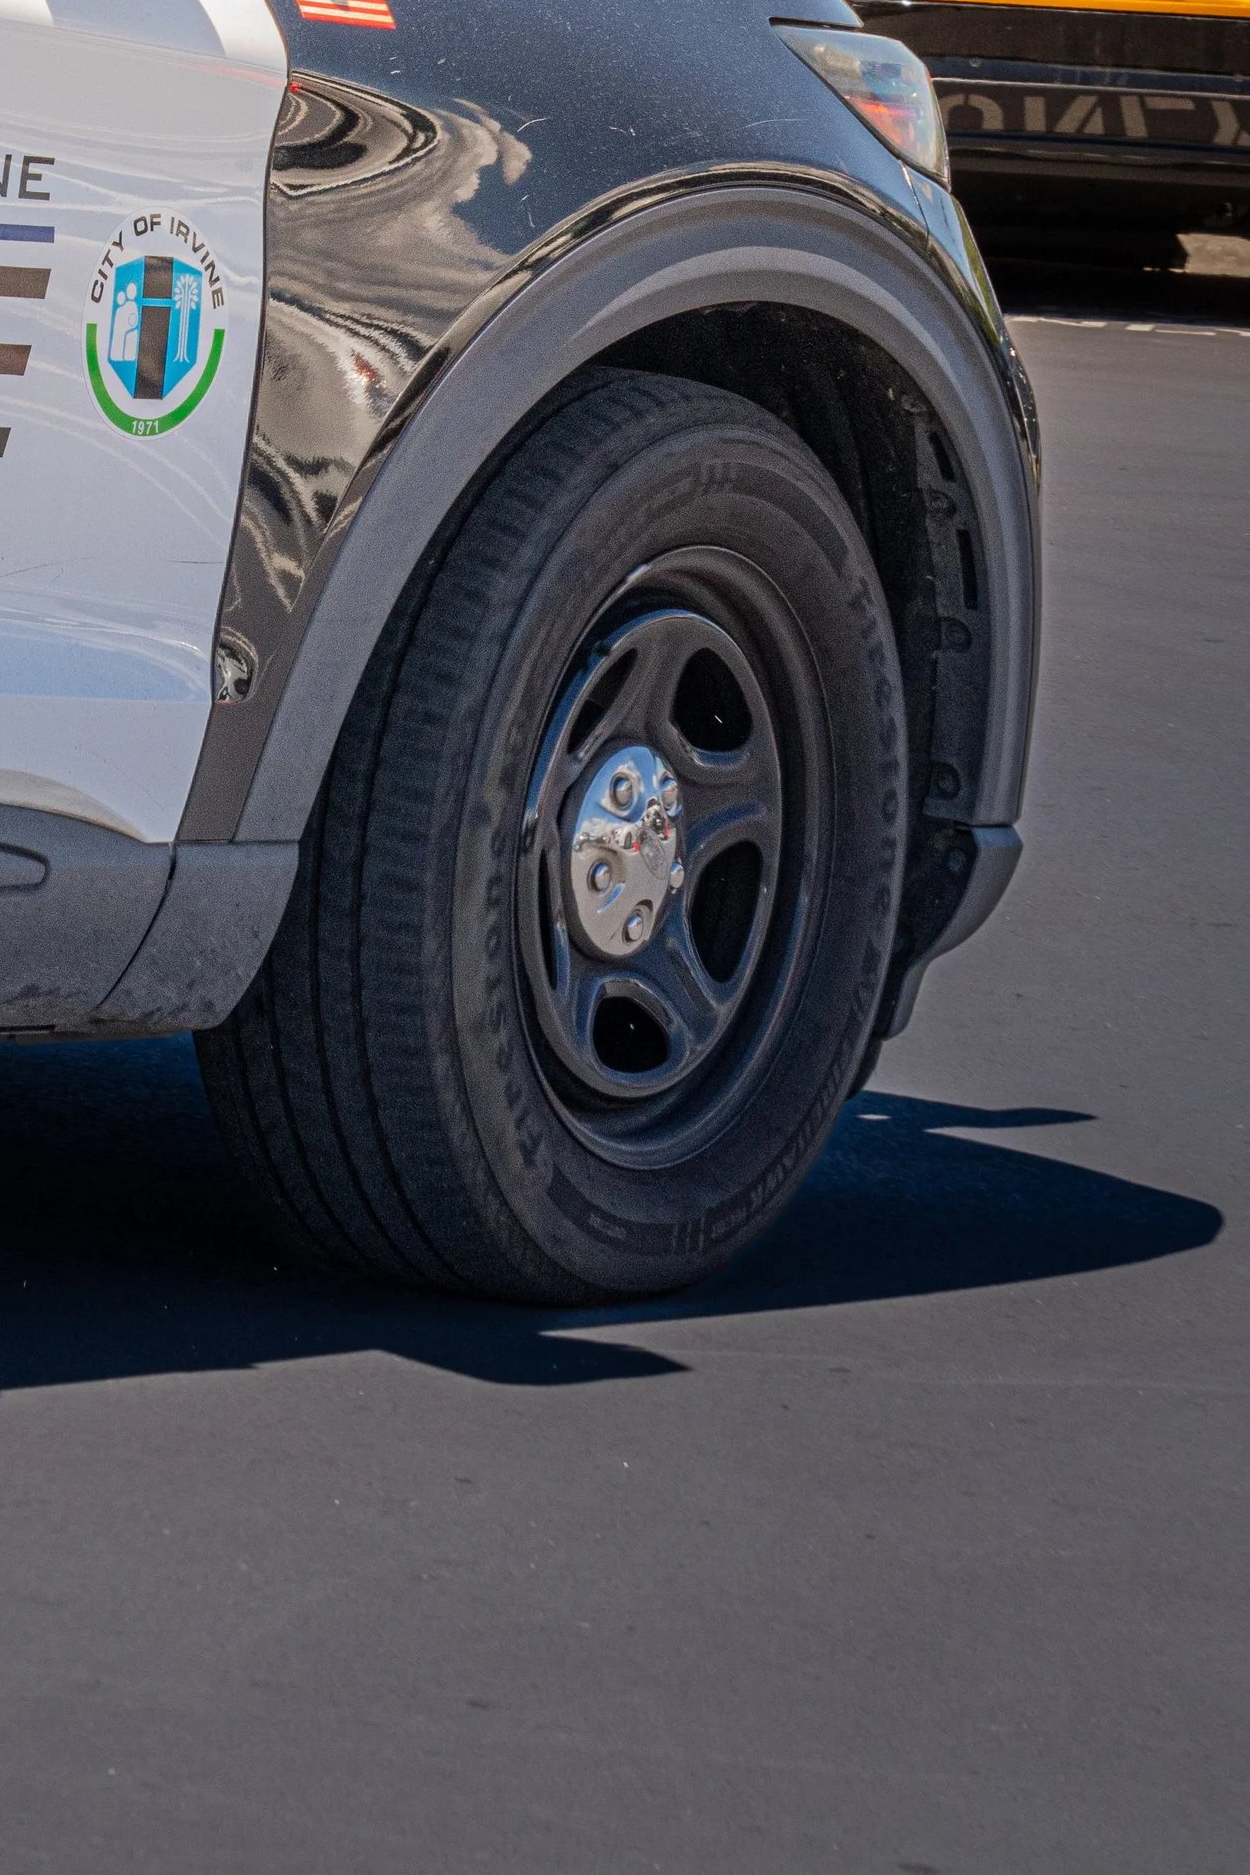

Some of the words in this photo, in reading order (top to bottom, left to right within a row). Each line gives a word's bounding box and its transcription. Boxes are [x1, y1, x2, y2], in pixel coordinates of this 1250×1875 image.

[90, 230, 125, 304] CITY
[133, 213, 162, 237] OF
[170, 216, 225, 310] IRVINE
[131, 419, 160, 436] 1971
